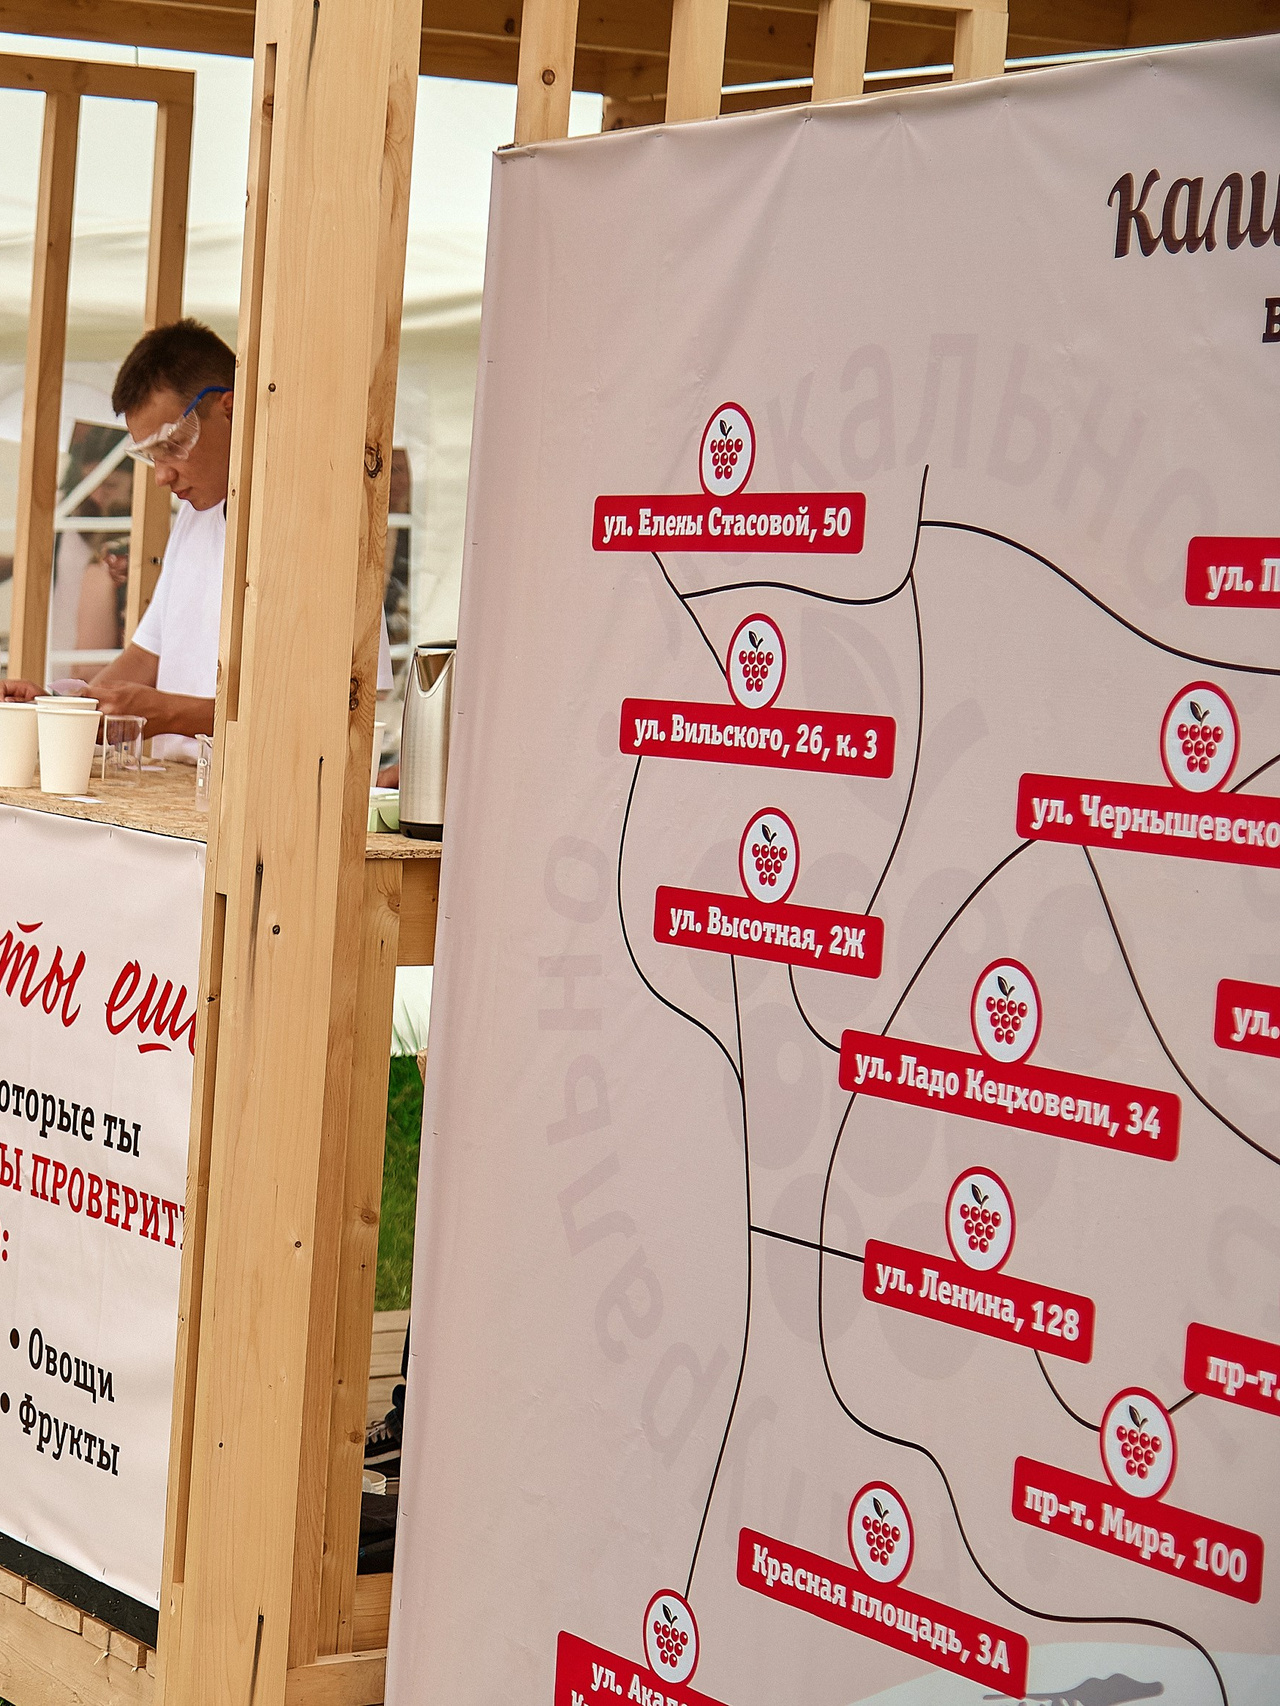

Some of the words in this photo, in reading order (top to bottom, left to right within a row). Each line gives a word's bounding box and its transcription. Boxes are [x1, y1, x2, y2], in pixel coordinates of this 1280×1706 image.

[603, 516, 634, 544] ул.
[639, 509, 704, 537] Елены
[708, 506, 818, 544] Стасовой,
[823, 507, 852, 537] 50
[1206, 565, 1254, 601] ул.
[634, 719, 666, 748] ул.
[671, 714, 791, 758] Вильского,
[796, 724, 831, 762] 26,
[837, 735, 858, 759] к.
[863, 730, 878, 760] 3
[1031, 797, 1074, 831] ул.
[1080, 793, 1280, 849] Чернышевско
[669, 908, 702, 937] ул.
[707, 906, 824, 959] Высотная,
[829, 926, 866, 960] 2Ж
[1231, 1007, 1280, 1043] ул.
[854, 1053, 893, 1085] ул.
[898, 1055, 960, 1100] Ладо
[965, 1068, 1120, 1138] Кецховели,
[1126, 1102, 1161, 1140] 34
[104, 1113, 142, 1158] ты
[31, 1154, 186, 1251] ПРОВЕРИТ
[875, 1263, 914, 1295] ул.
[919, 1268, 1025, 1333] Ленина,
[1032, 1301, 1080, 1342] 128
[29, 1328, 115, 1404] Овощи
[1207, 1356, 1280, 1402] пр-т.
[19, 1393, 120, 1477] Фрукты
[1025, 1486, 1095, 1531] пр-т.
[1100, 1503, 1186, 1570] Мира,
[1195, 1538, 1248, 1583] 100
[752, 1544, 847, 1608] Красная
[852, 1591, 971, 1664] площадь,
[976, 1634, 1010, 1674] 3А
[591, 1662, 623, 1696] ул.
